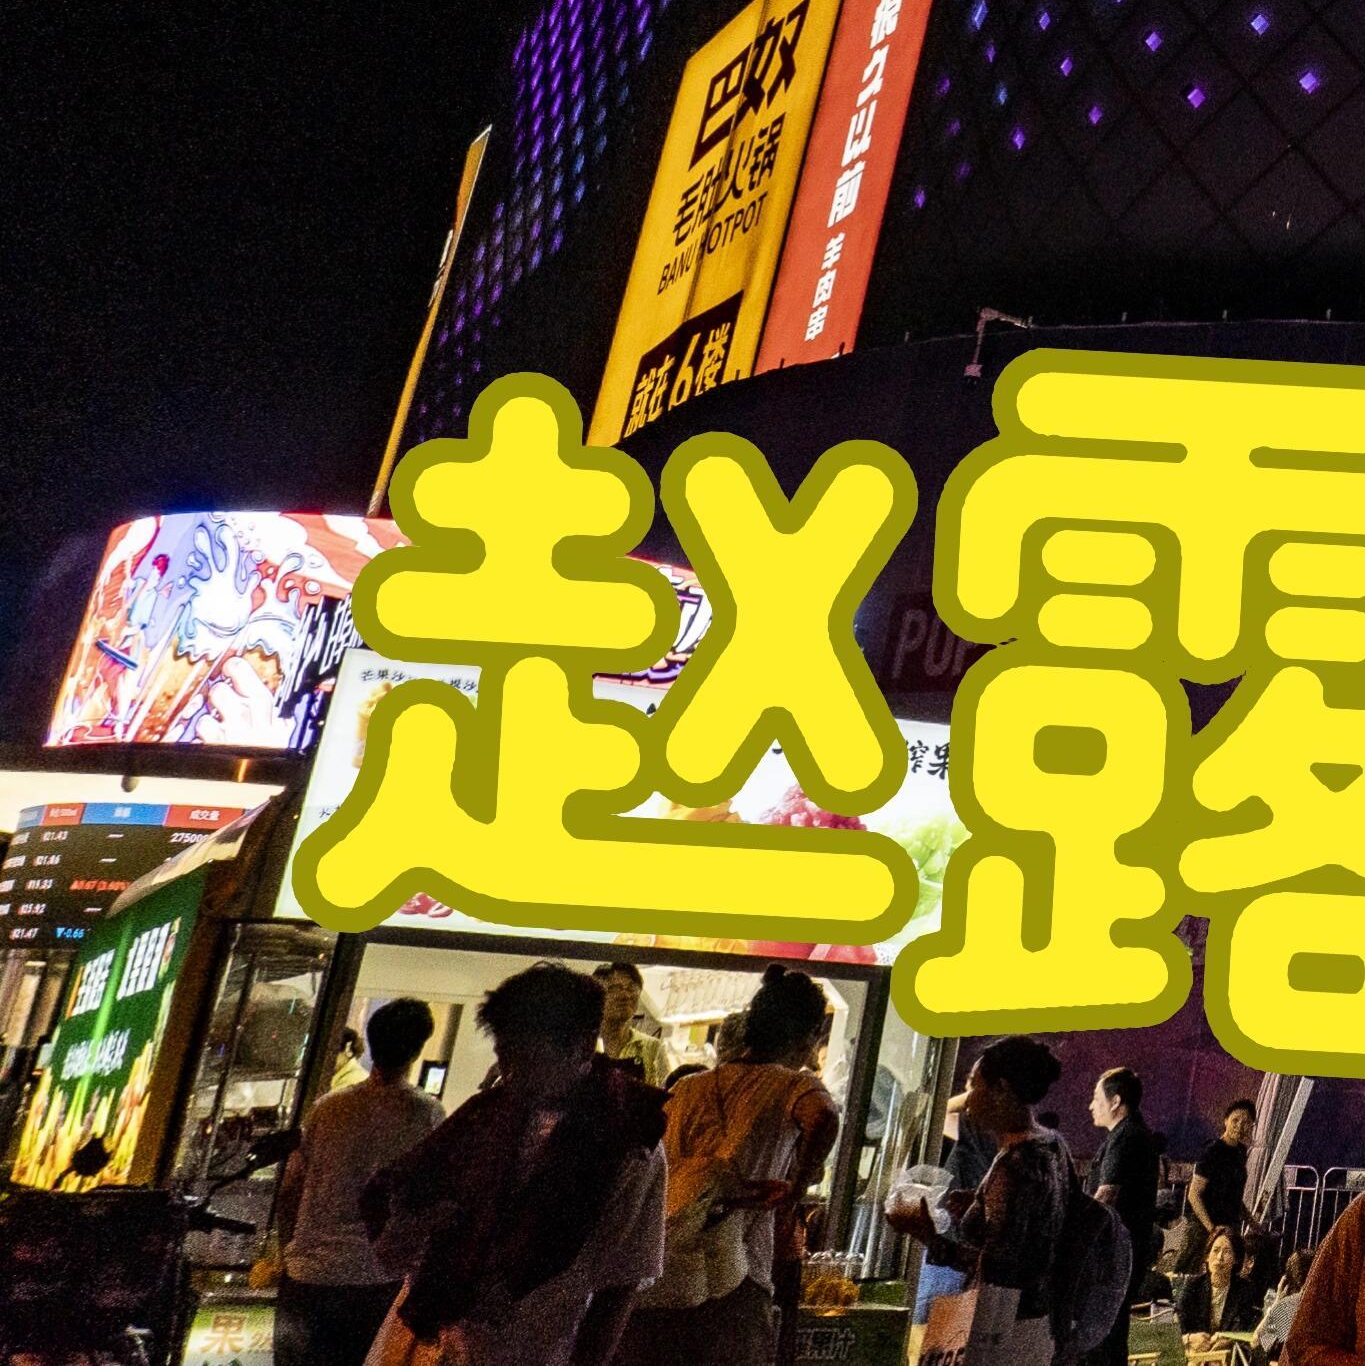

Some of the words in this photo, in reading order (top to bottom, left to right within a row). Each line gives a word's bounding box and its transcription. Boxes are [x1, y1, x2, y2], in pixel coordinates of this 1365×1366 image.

[672, 112, 787, 247] 毛肚火锅
[657, 238, 698, 296] BANU
[698, 191, 769, 261] HOTPOT
[804, 232, 846, 342] 羊肉串
[623, 322, 731, 439] 就在6楼
